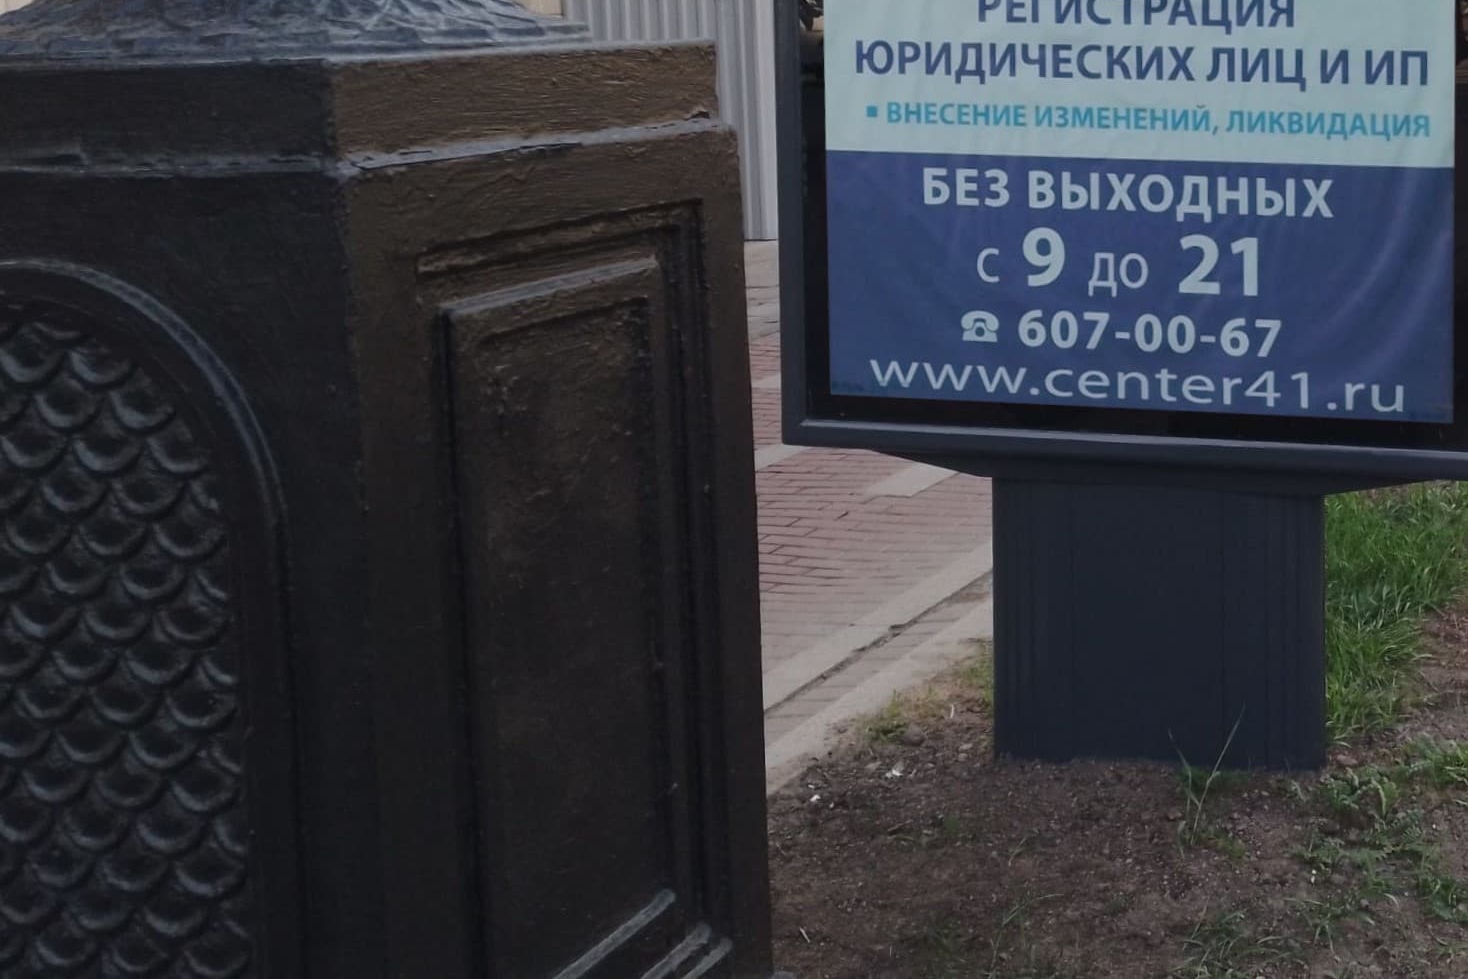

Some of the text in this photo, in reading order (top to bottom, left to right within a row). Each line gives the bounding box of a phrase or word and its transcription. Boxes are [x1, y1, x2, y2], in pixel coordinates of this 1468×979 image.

[856, 40, 1428, 92] ЮРИДИЧЕСКИХ ЛИЦ И ИП
[888, 102, 1429, 141] ВНЕСЕНИЕ ИЗМЕНЕНИЙ, ЛИКВИДАЦИЯ
[923, 168, 1333, 223] БЕЗ ВЫХОДНЫХ
[1023, 227, 1065, 286] 9
[1179, 234, 1258, 296] 21
[1019, 310, 1281, 357] 607-00-67
[868, 358, 1405, 413] www.center41.ru
